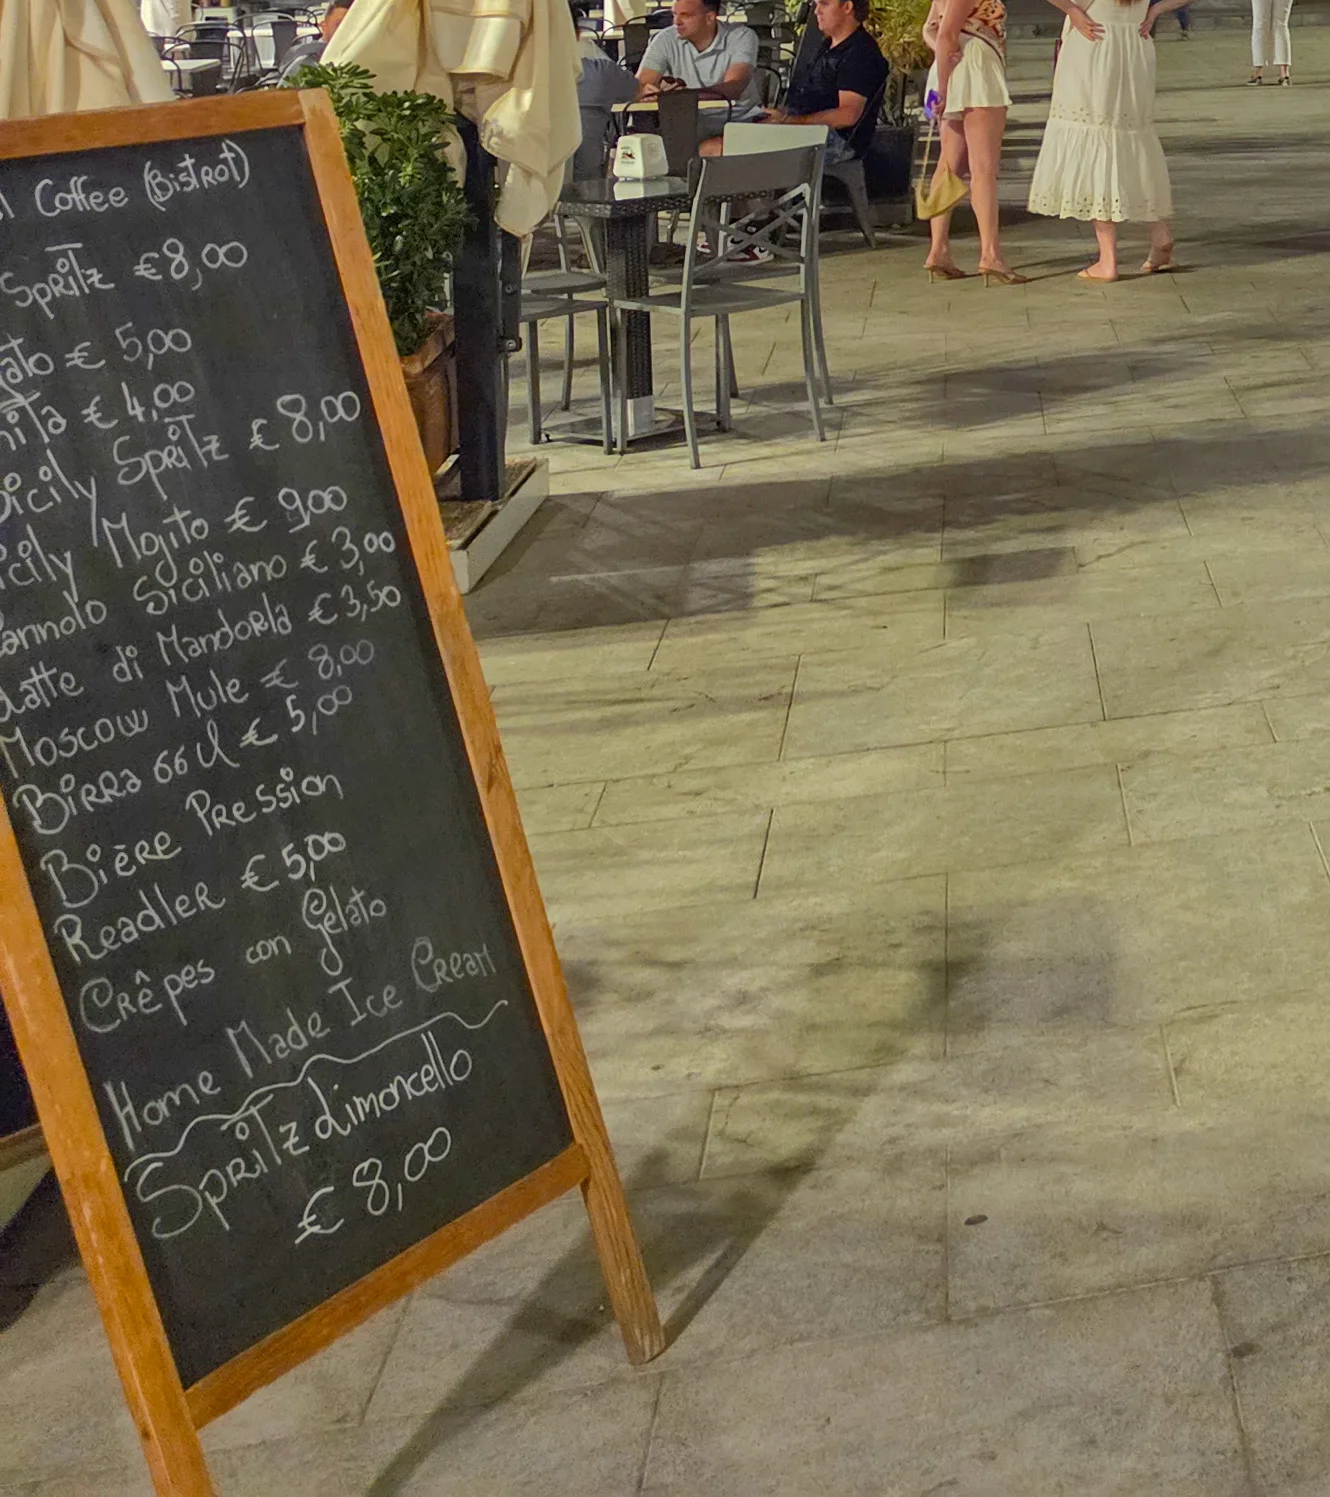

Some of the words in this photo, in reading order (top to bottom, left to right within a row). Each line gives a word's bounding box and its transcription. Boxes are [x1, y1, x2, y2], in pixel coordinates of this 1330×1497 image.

[35, 176, 129, 217] Coffee
[65, 342, 106, 370] €
[115, 322, 192, 370] 5,00
[81, 395, 118, 429] €
[121, 381, 195, 422] 4,00
[277, 391, 361, 442] 8,00
[101, 504, 209, 587] Mojito
[224, 496, 267, 533] €
[0, 590, 107, 657] annolo
[133, 550, 287, 614] Siciliano
[300, 539, 328, 573] €
[331, 526, 395, 576] 3,00
[112, 645, 144, 682] di
[307, 592, 338, 625] €
[340, 576, 401, 621] 3,50
[0, 709, 148, 779] Moscow
[165, 668, 249, 718] Mule
[260, 658, 299, 688] €
[308, 639, 374, 680] 8,00
[239, 717, 279, 748] €
[286, 685, 352, 736] 5,00
[185, 766, 344, 836] Pression
[240, 854, 280, 892] €
[282, 832, 346, 881] 5,00
[80, 960, 215, 1033] Crêpes
[246, 935, 292, 965] con
[302, 885, 386, 976] Gelato
[103, 1071, 221, 1152] Home
[225, 1007, 331, 1078] Made
[327, 977, 403, 1027] Ice
[314, 1030, 472, 1140] Limoncello
[294, 1186, 344, 1244] €
[352, 1126, 451, 1216] 8,00
